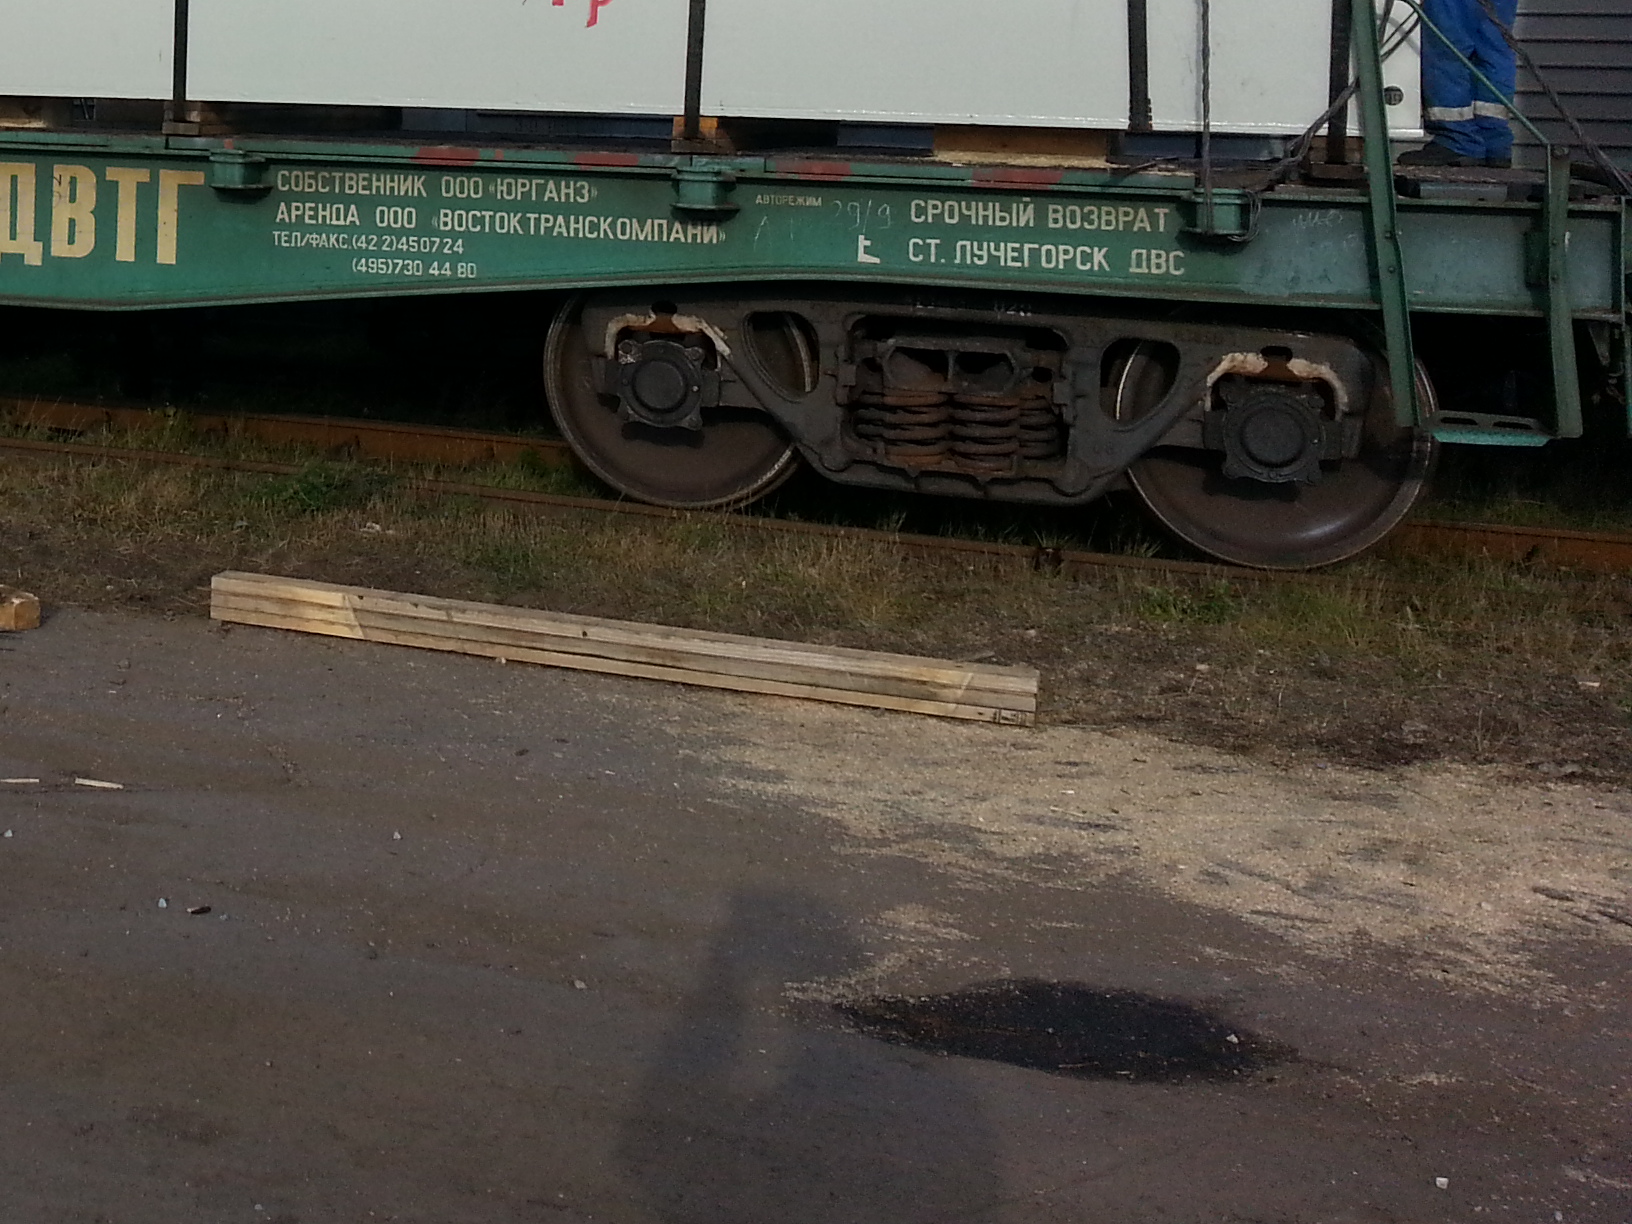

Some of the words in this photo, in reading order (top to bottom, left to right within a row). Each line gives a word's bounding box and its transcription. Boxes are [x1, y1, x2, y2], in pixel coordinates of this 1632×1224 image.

[277, 170, 427, 197] СОБСТВЕННИК
[441, 176, 483, 199] ООО
[755, 194, 822, 207] АВТОРЕЖИМ
[275, 201, 360, 226] АРЕНДА
[376, 206, 417, 229] ООО
[910, 197, 1035, 227] СРОЧНЫЙ
[1048, 205, 1169, 233] ВОЗВРАТ
[428, 262, 452, 277] 44
[458, 263, 477, 278] 80
[908, 238, 945, 264] СТ.
[954, 240, 1110, 271] ЛУЧЕГОРСК
[1129, 248, 1185, 275] ДВС
